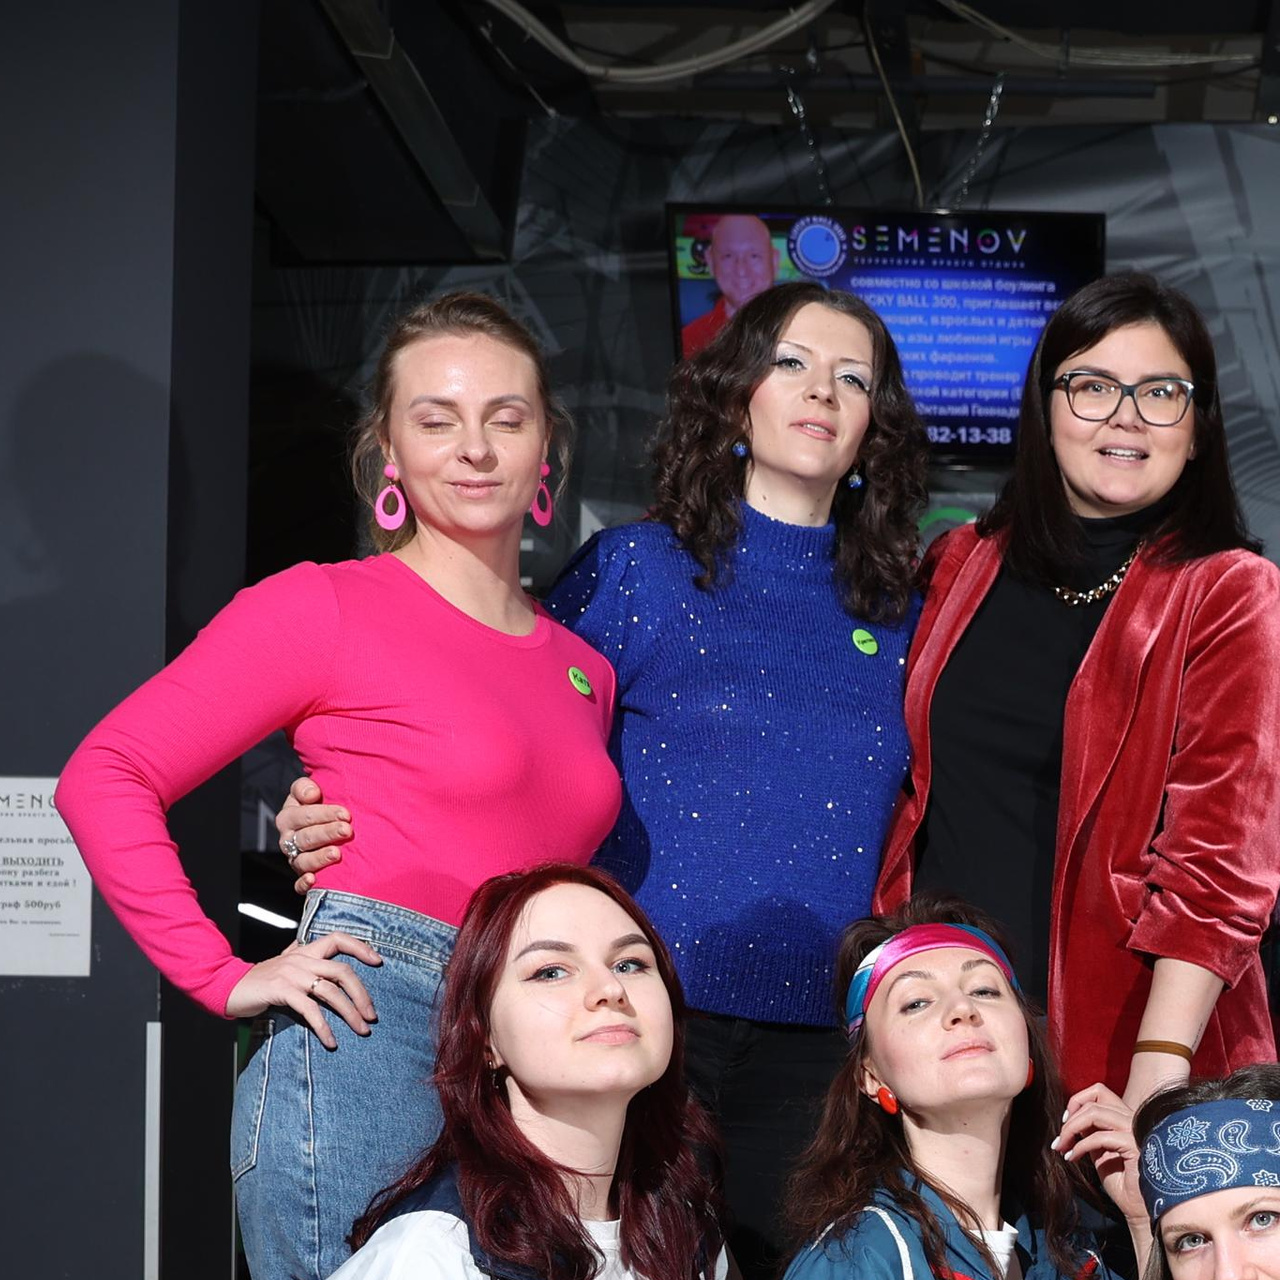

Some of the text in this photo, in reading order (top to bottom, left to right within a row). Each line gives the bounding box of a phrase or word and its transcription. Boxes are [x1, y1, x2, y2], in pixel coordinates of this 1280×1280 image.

[851, 225, 1027, 254] SEMENOV
[941, 276, 993, 292] школой
[994, 277, 1057, 294] боулинга
[858, 291, 894, 308] UCKY
[896, 292, 929, 309] BALL
[1007, 316, 1047, 331] детей
[926, 425, 1013, 445] 82-13-38
[2, 856, 64, 867] ВЫХОДИТЬ
[22, 868, 60, 878] разбега
[1, 899, 61, 911] раф 500руб
